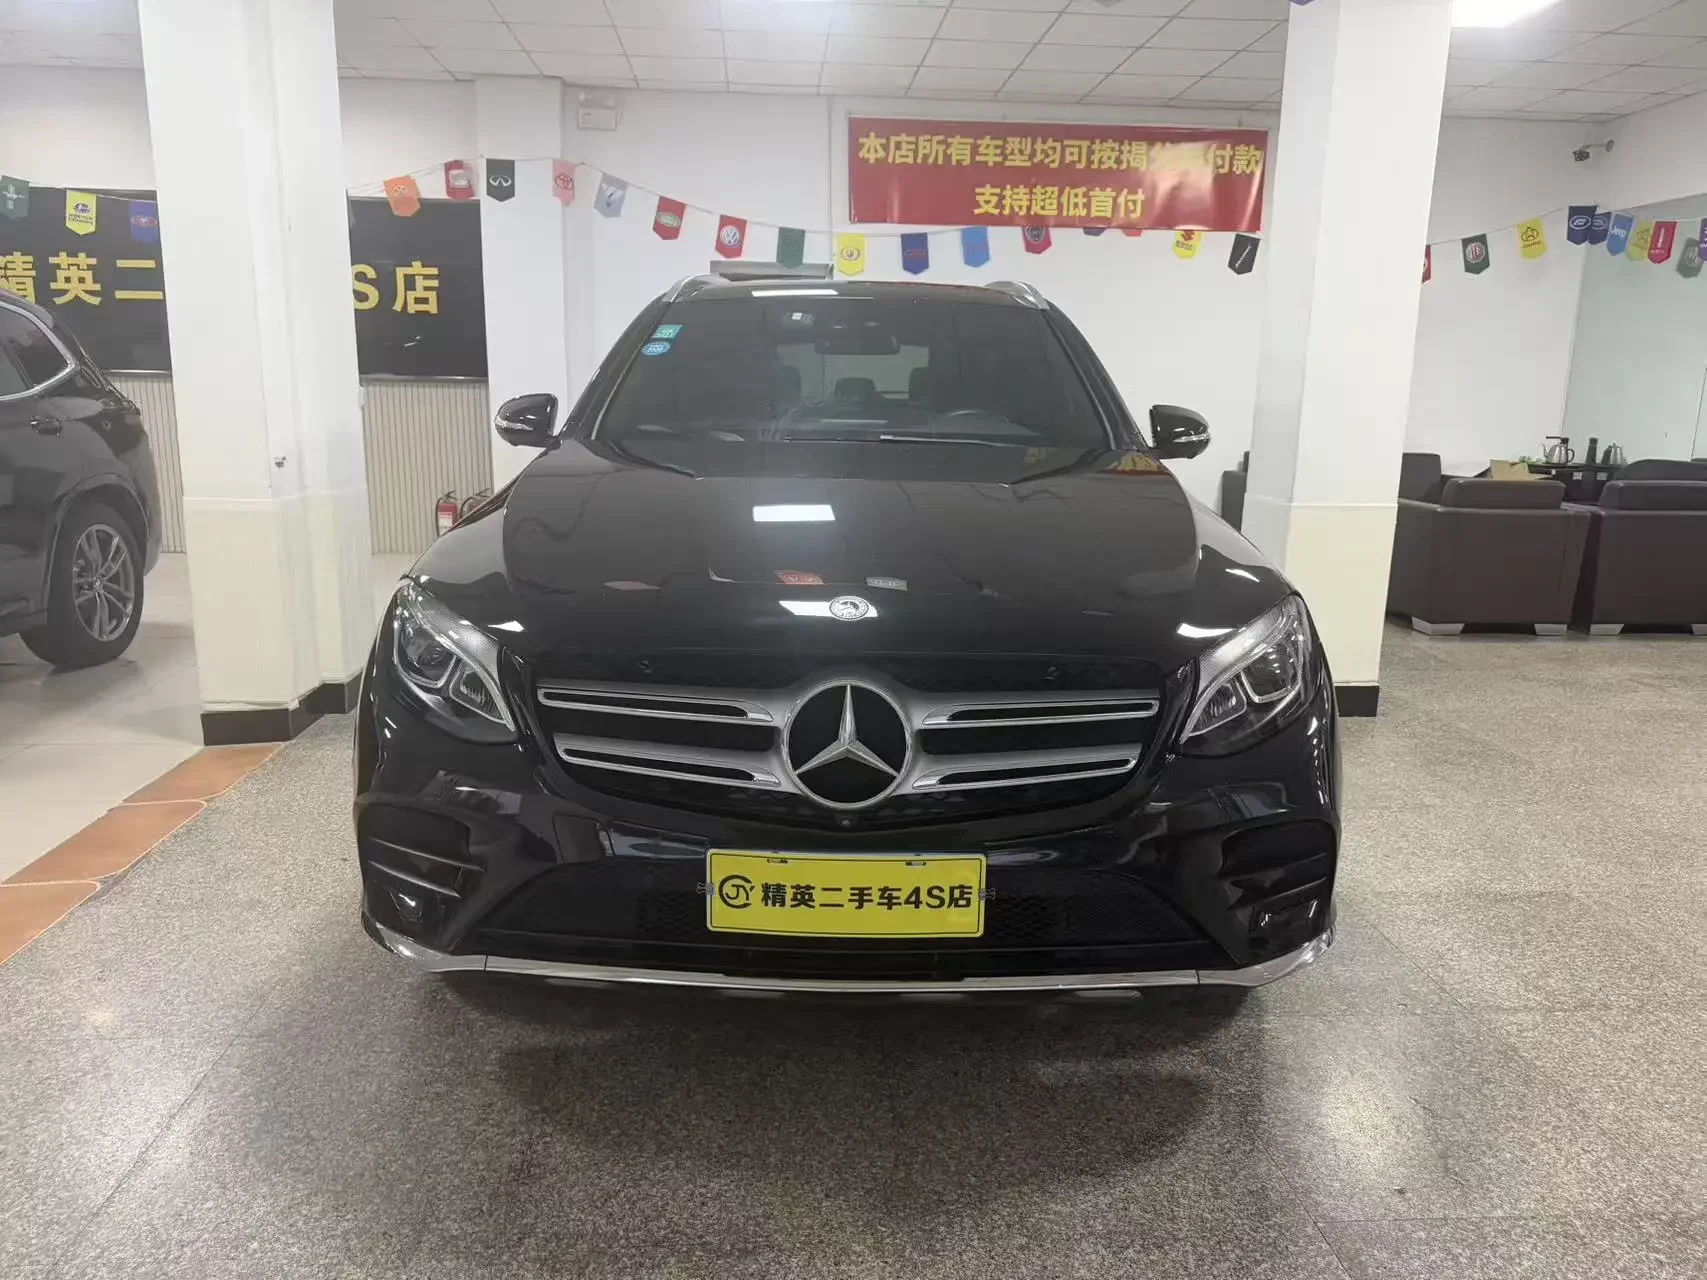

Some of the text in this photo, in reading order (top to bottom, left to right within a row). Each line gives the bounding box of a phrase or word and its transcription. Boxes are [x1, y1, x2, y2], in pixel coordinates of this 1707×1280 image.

[857, 131, 1263, 175] 本店所有车型均可按揭付款
[973, 184, 1146, 219] 支持超低首付
[351, 260, 440, 314] S店
[760, 882, 973, 911] 精英二手车4S店
